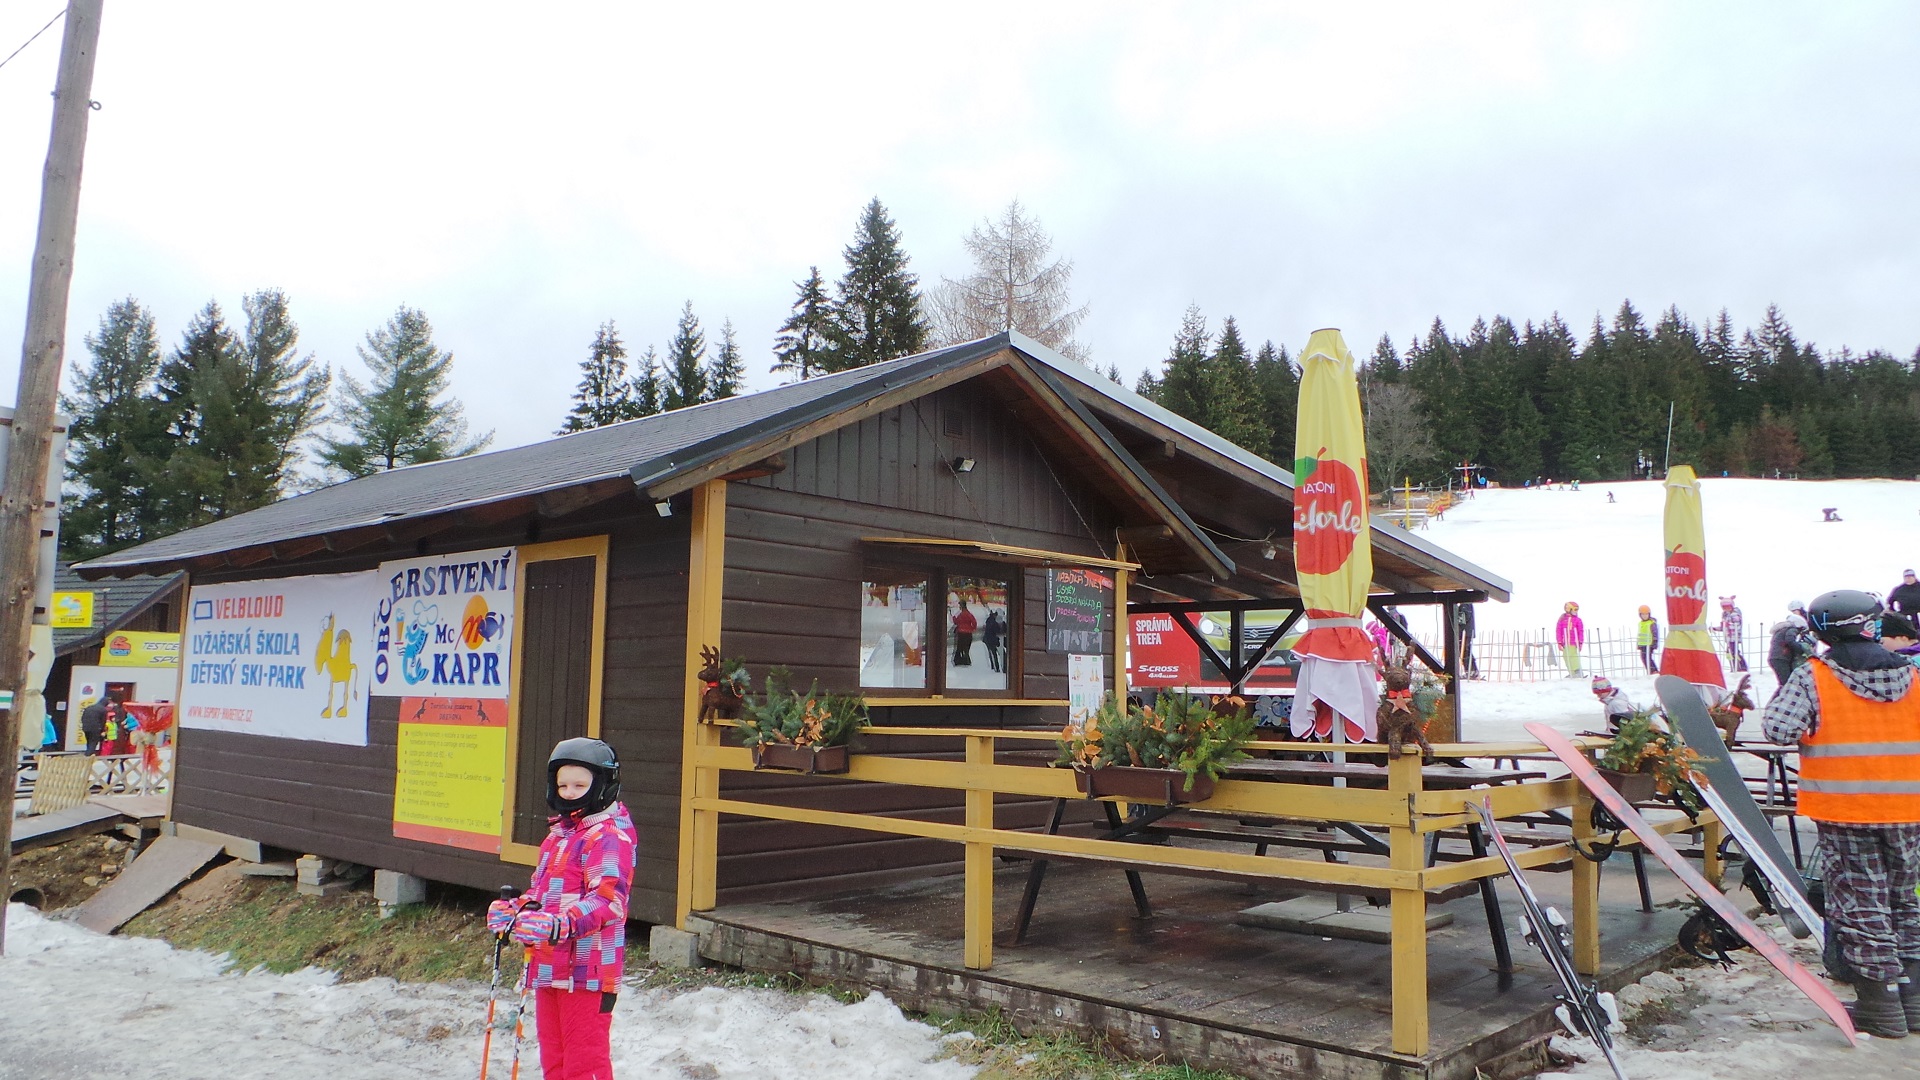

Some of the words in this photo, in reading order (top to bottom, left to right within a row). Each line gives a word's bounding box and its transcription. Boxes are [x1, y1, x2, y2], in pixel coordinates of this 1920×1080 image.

[216, 595, 284, 619] VELBLOUD
[1135, 617, 1173, 632] SPRÁVNÁ
[193, 627, 251, 654] LYŽAŘSKÁ
[256, 630, 300, 655] ŠKOLA
[1136, 633, 1162, 646] TREFA
[191, 658, 237, 684] DĚTSKÝ
[241, 663, 306, 690] SKI-PARK
[432, 653, 501, 686] KAPR
